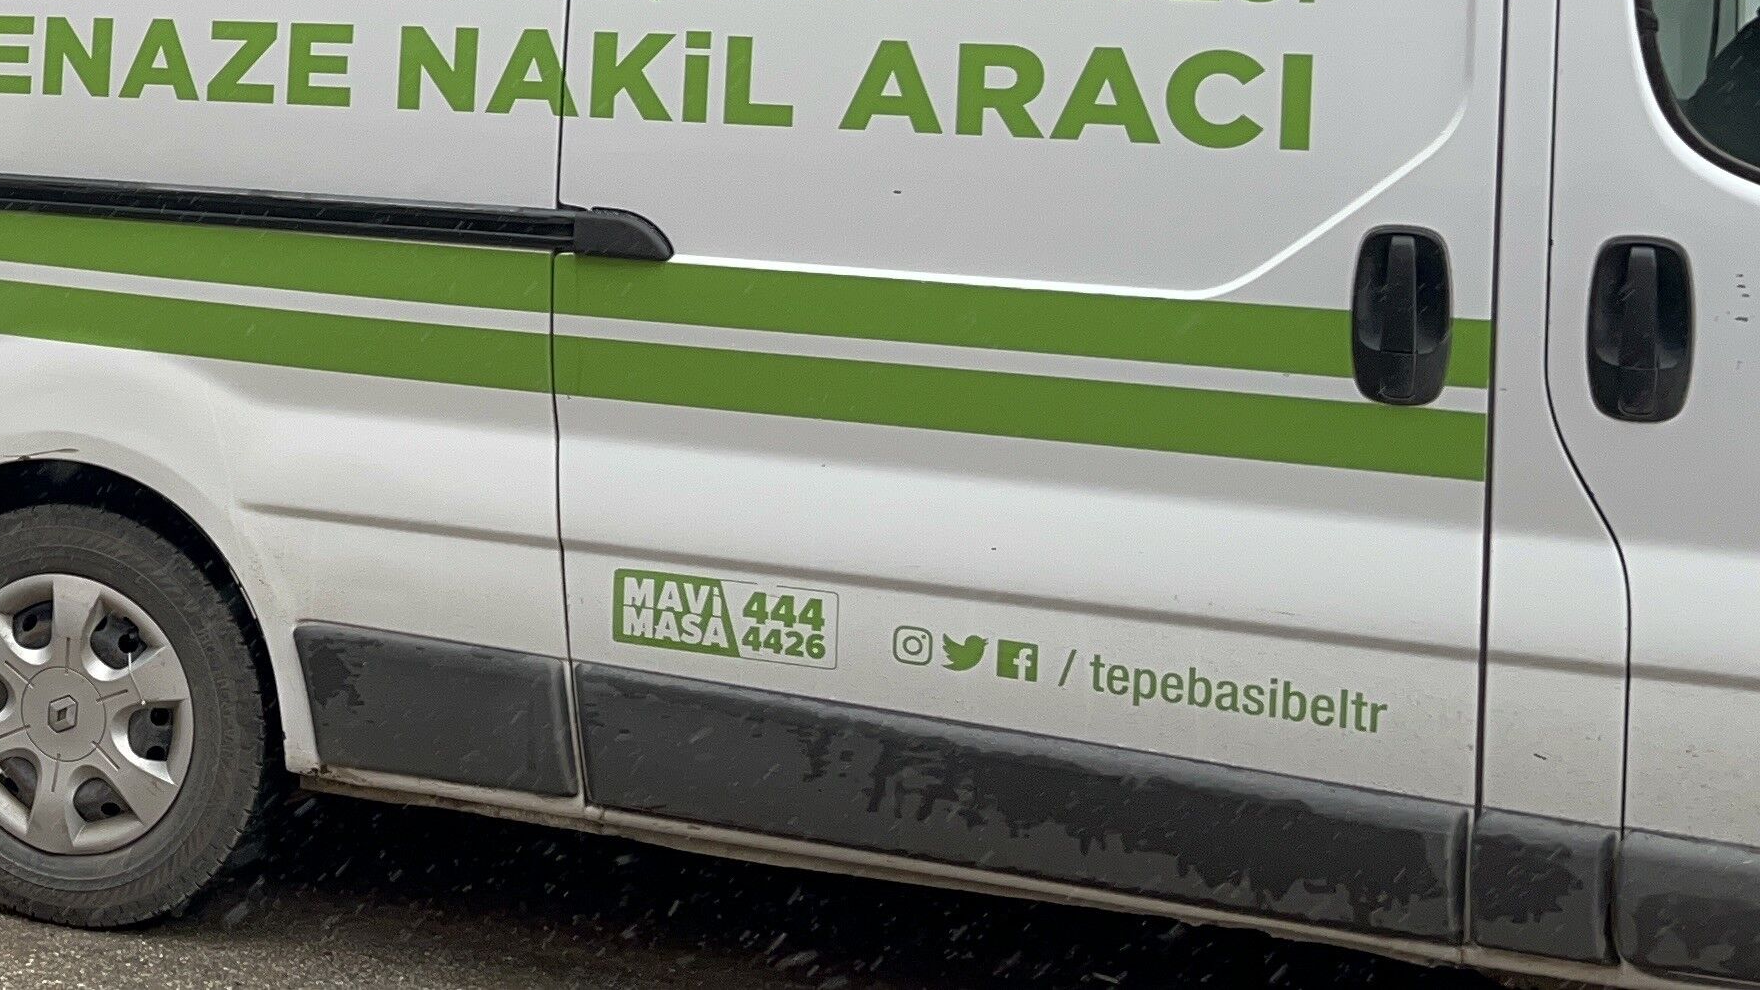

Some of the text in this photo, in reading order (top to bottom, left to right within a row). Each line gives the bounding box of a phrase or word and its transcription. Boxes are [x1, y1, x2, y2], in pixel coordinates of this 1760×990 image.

[838, 38, 1315, 152] ARACI
[622, 605, 730, 649] MASA
[742, 591, 826, 632] 444
[742, 625, 827, 660] 4426
[1089, 653, 1388, 734] tepebasibeltr
